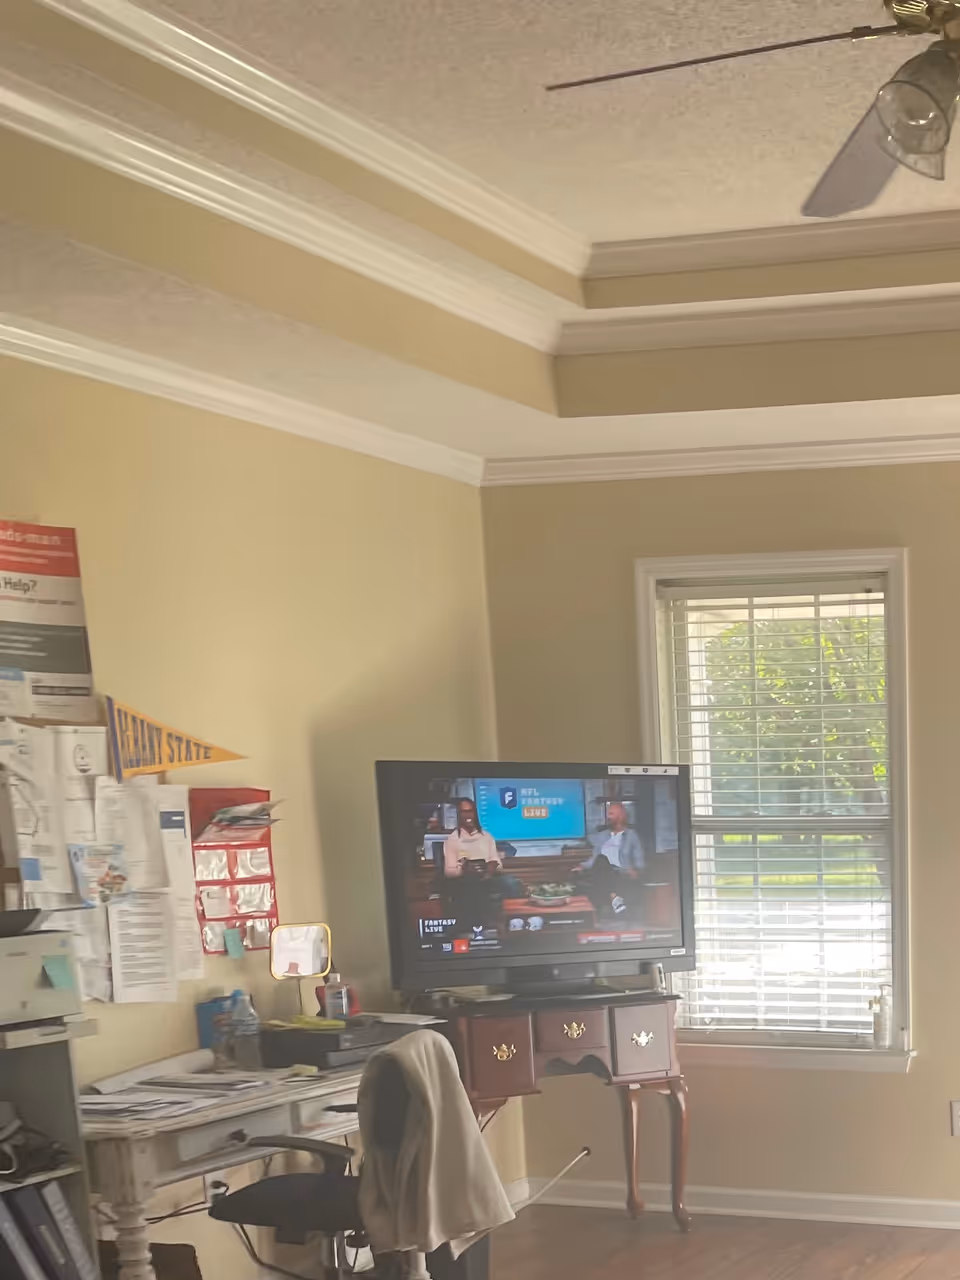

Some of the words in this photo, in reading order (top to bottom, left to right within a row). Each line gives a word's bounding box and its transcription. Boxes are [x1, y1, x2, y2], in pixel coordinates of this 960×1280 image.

[4, 576, 39, 594] Help?
[166, 731, 212, 763] STATE
[524, 808, 547, 817] LIVE
[424, 918, 457, 926] FANTASY
